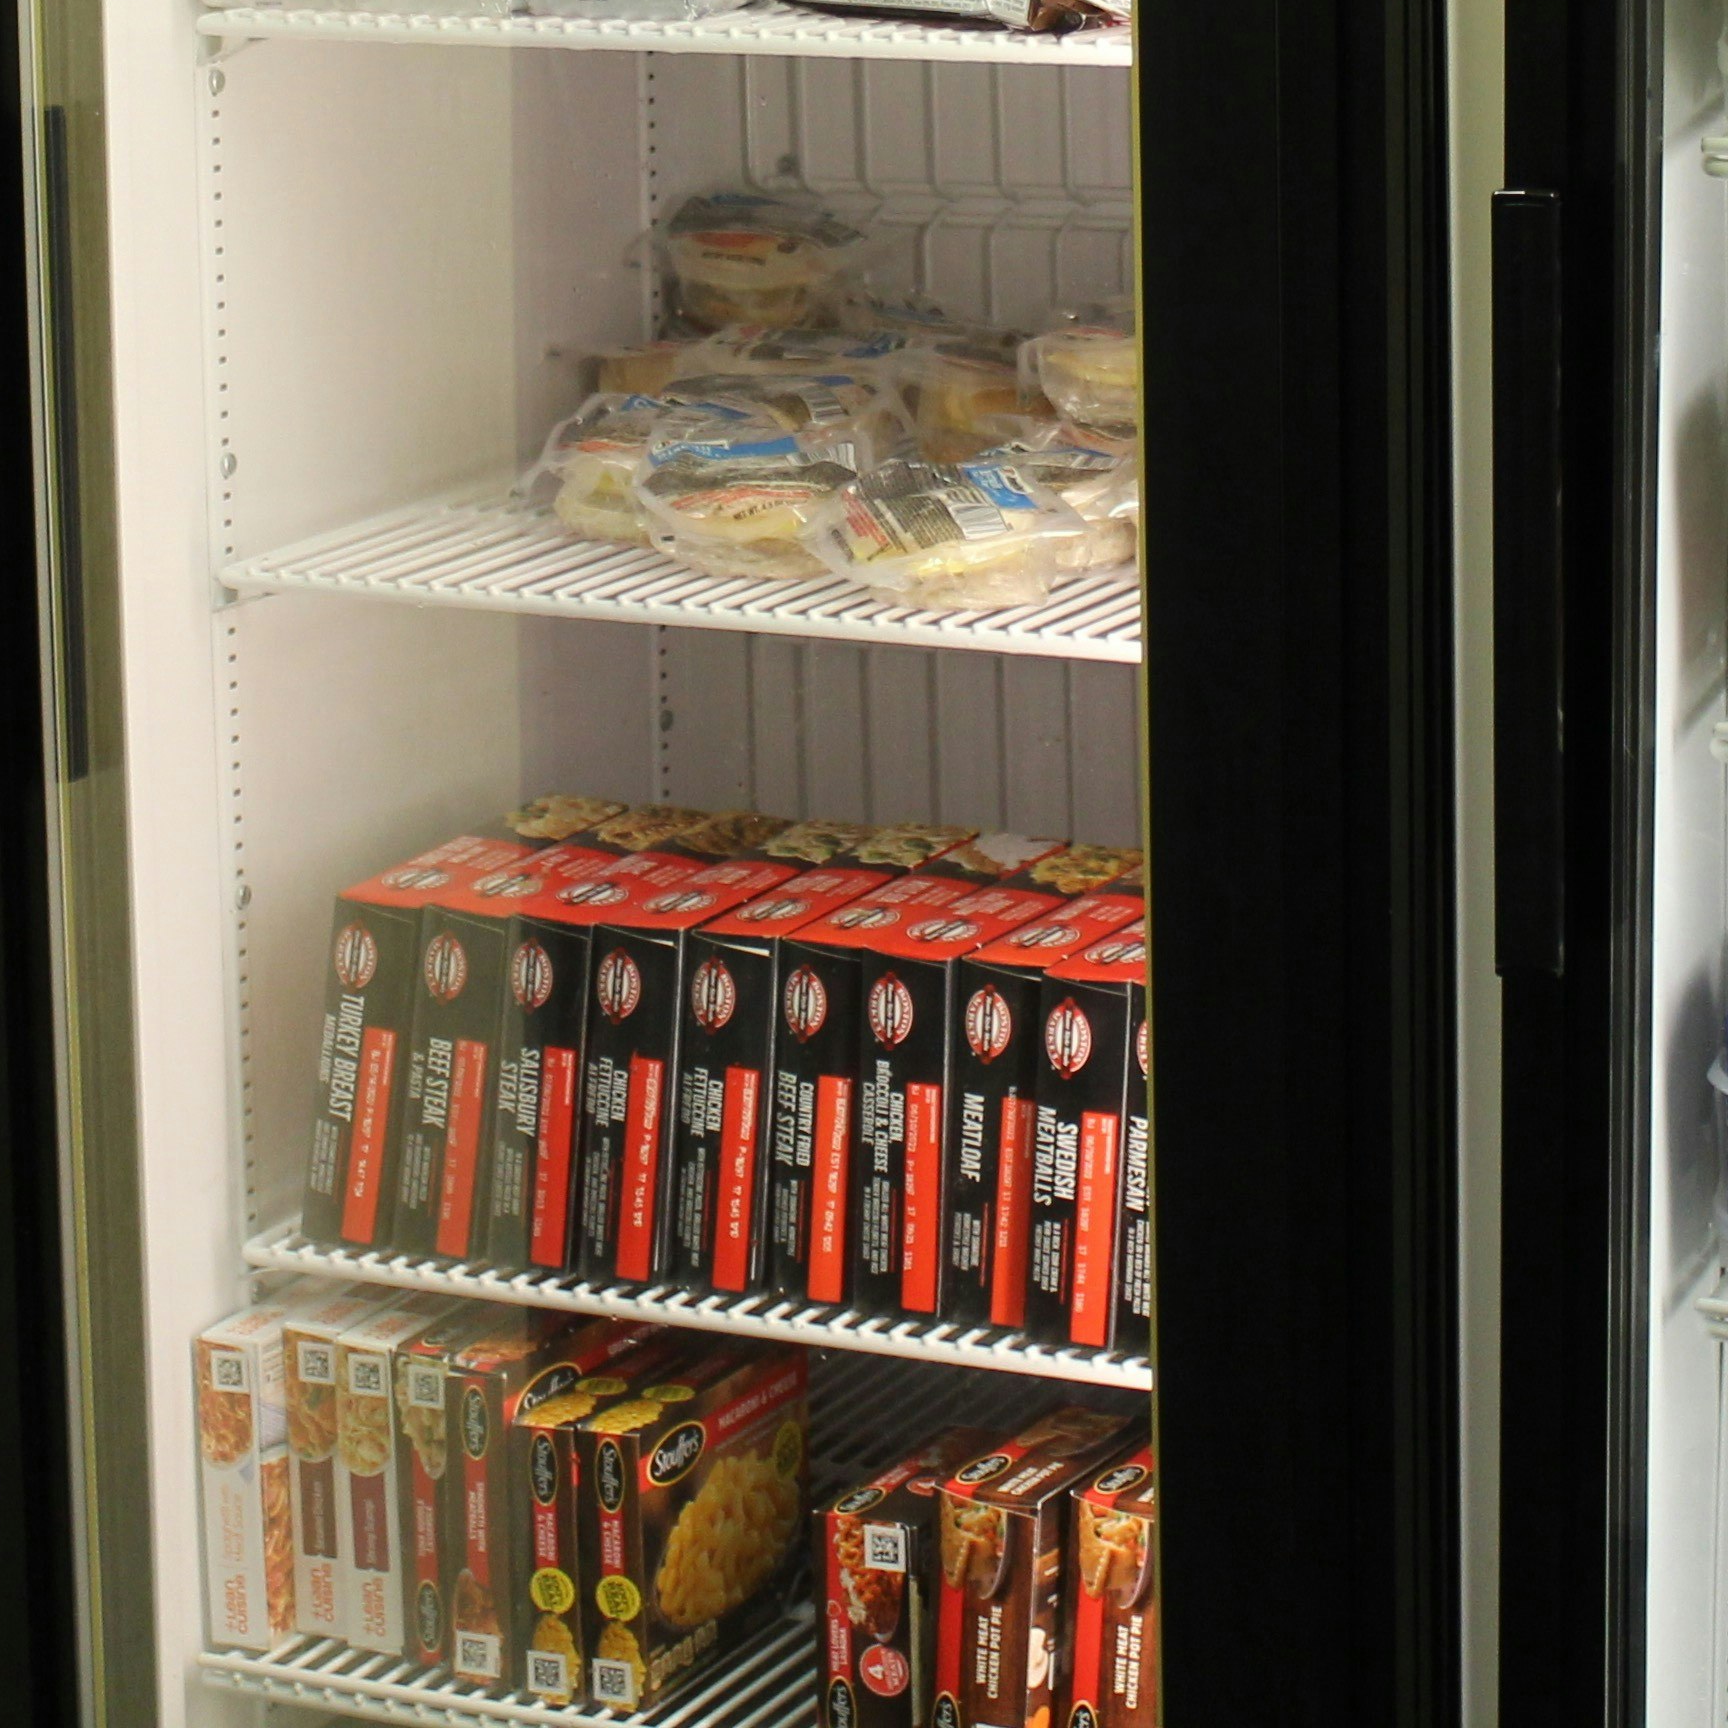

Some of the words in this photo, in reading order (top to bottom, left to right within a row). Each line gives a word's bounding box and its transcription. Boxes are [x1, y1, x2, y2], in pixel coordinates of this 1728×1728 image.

[335, 993, 364, 1057] TURKEY
[427, 1037, 452, 1078] BEEF
[329, 1058, 357, 1121] BREAST
[423, 1079, 449, 1129] STEAK
[498, 1060, 518, 1114] STEAK
[515, 1047, 540, 1137] SALISBURY
[596, 1057, 613, 1128] FETTUCCINE
[611, 1069, 629, 1122] CHICKEN
[690, 1067, 708, 1138] FETTUCCINE
[706, 1078, 723, 1132] CHICKEN
[776, 1071, 797, 1113] BEEF
[798, 1082, 815, 1134] COUNTRY
[775, 1114, 796, 1166] STEAK
[960, 1093, 985, 1183] MEATLOAF
[1033, 1105, 1058, 1207] MEATBALLS
[1053, 1121, 1080, 1201] SWEDISH
[1125, 1116, 1149, 1212] PARMESAN
[978, 1616, 988, 1649] MEAT
[990, 1631, 1001, 1651] POT
[992, 1606, 1003, 1626] PIE
[1117, 1625, 1129, 1653] MEAT
[1131, 1615, 1143, 1635] PIE
[975, 1652, 987, 1684] WHITE
[1129, 1639, 1141, 1660] POT
[987, 1657, 999, 1699] CHICKEN
[1114, 1659, 1126, 1693] WHITE
[1125, 1664, 1139, 1708] CHICKEN
